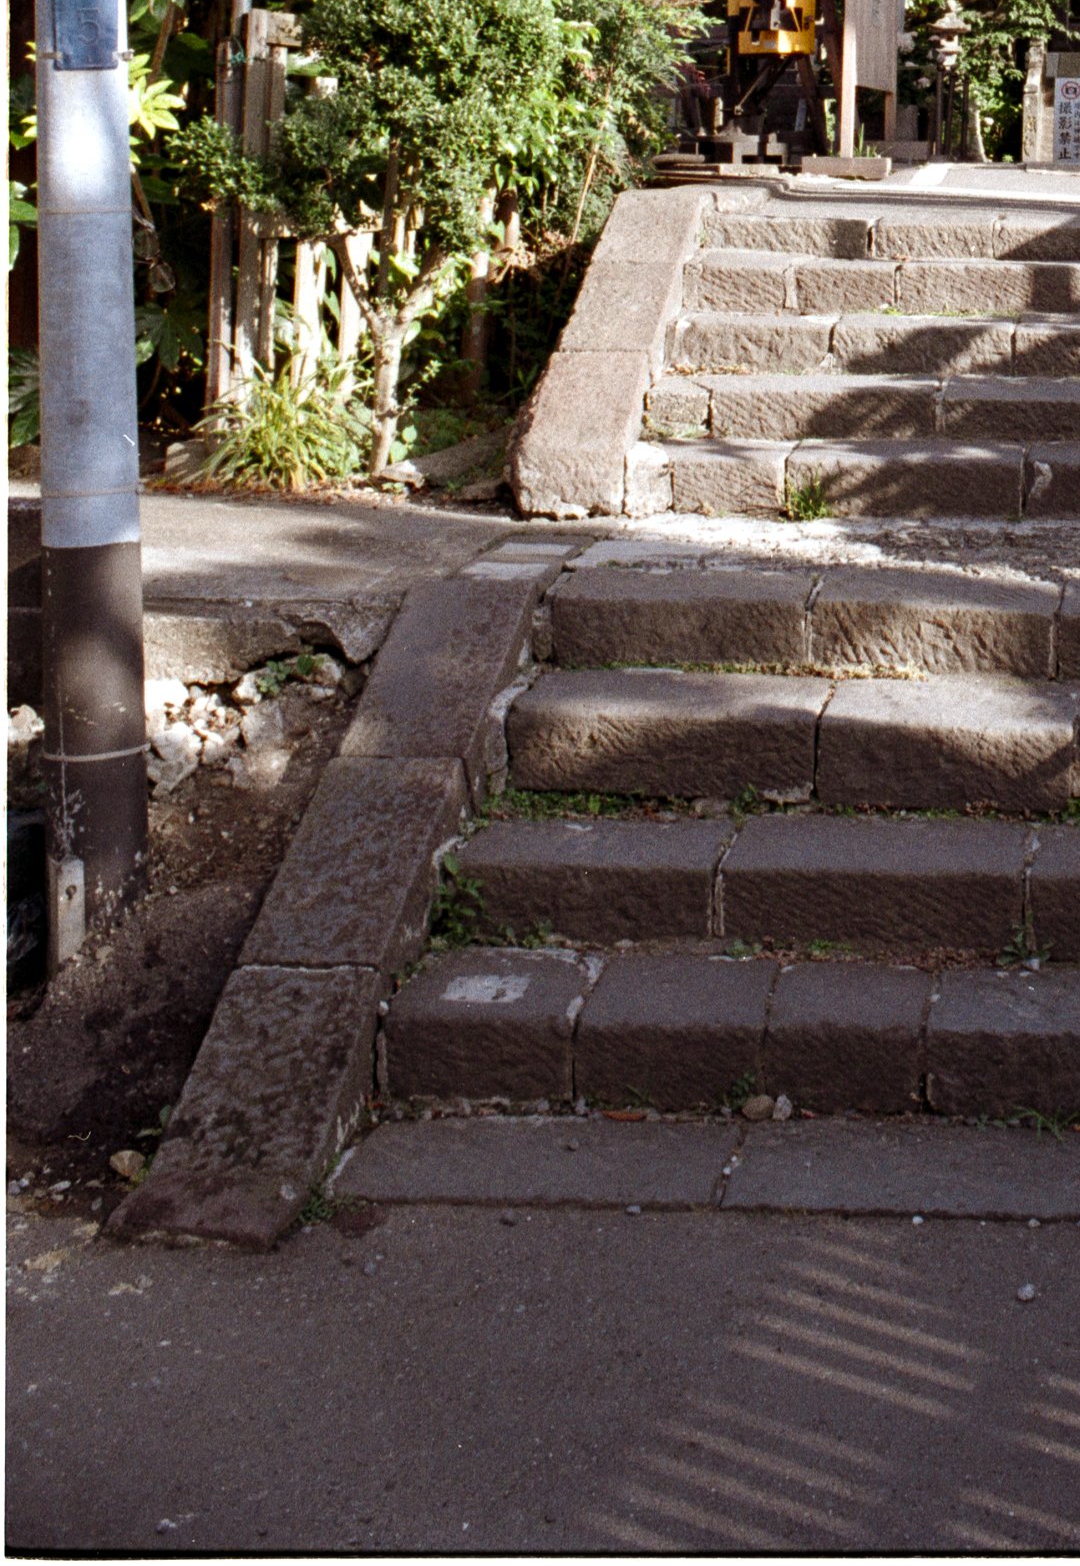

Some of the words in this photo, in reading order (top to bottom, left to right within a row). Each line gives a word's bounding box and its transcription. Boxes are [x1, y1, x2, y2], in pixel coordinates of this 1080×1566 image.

[76, 7, 100, 45] 5
[1057, 101, 1073, 160] 撮影禁止
